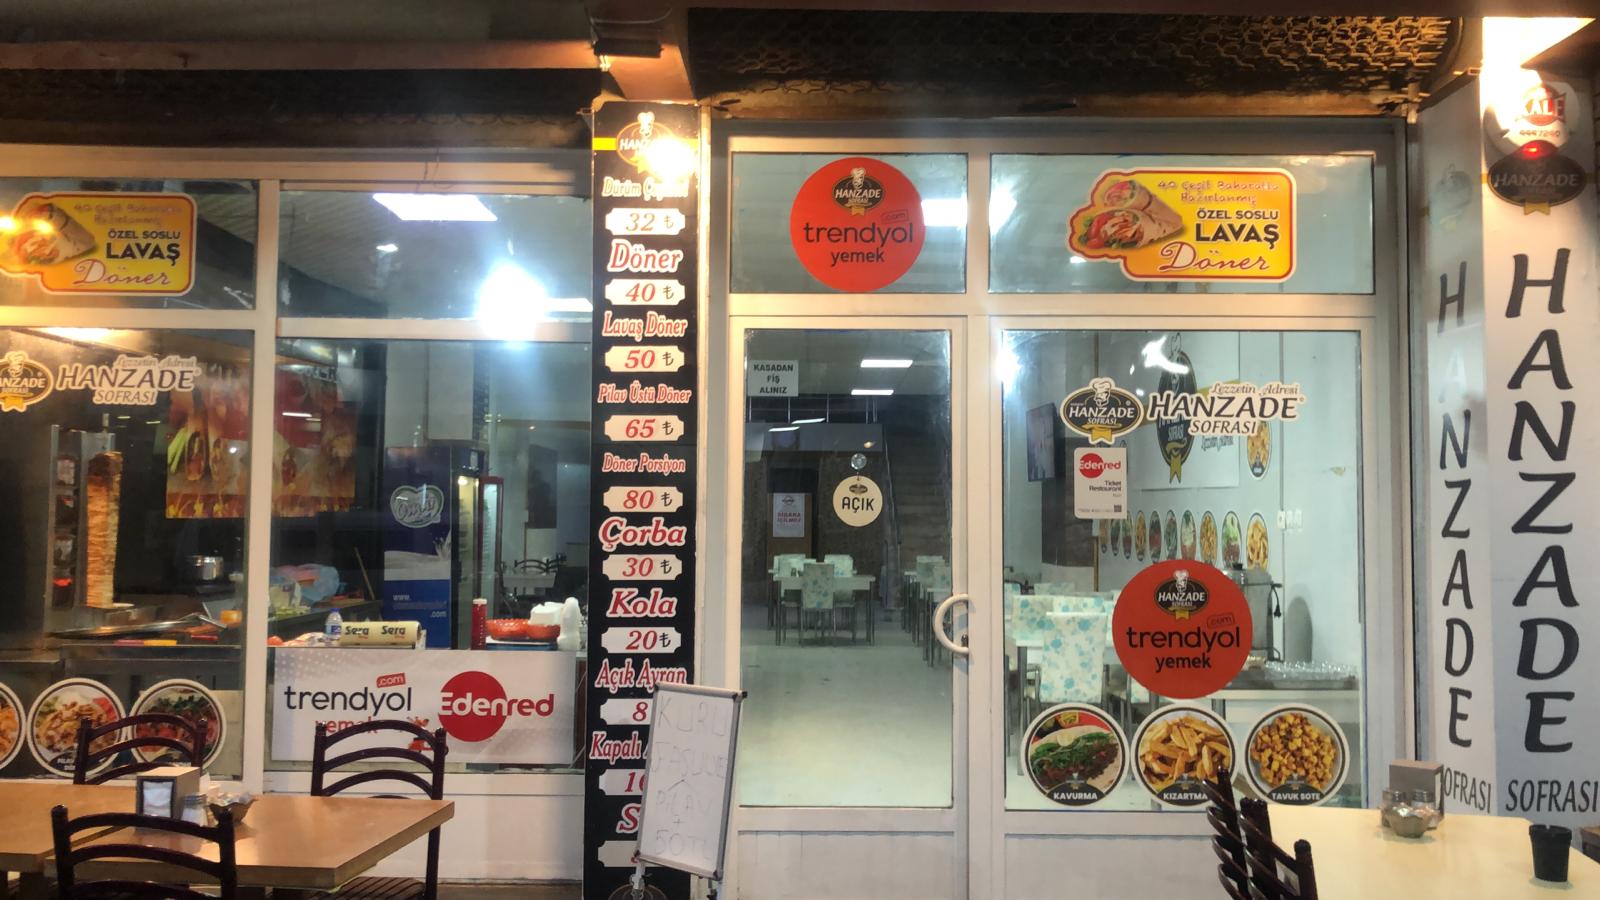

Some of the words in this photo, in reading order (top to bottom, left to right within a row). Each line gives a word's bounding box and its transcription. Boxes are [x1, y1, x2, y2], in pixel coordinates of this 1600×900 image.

[603, 177, 642, 197] Dürüm
[1496, 173, 1579, 187] HANZADE
[835, 188, 881, 200] HANZADE
[626, 213, 656, 232] 32
[1197, 209, 1232, 220] ÖZEL
[1235, 210, 1279, 220] SOSLU
[108, 230, 138, 240] ÖZEL
[142, 231, 181, 240] SOSLU
[803, 222, 913, 247] trendyol
[1196, 223, 1280, 249] LAVAŞ
[106, 243, 180, 266] LAVAŞ
[609, 241, 682, 271] Döner
[831, 248, 885, 267] yemek
[1159, 241, 1270, 271] Döner
[73, 258, 170, 286] Döner
[625, 283, 656, 302] 40
[603, 312, 643, 341] Lavaş
[646, 312, 688, 336] Döner
[624, 350, 656, 369] 50
[662, 352, 674, 367] ₺
[753, 364, 794, 372] KASADAN
[0, 377, 46, 389] NZADE
[59, 366, 194, 390] HANZADE
[767, 374, 780, 384] FİŞ
[95, 391, 156, 404] SOFRASI
[598, 384, 627, 403] Pilav
[629, 380, 656, 403] Üstü
[657, 384, 692, 403] Döner
[759, 386, 787, 394] ALINIZ
[1212, 382, 1256, 395] Lezzetin
[1258, 383, 1299, 396] Adresi
[1069, 405, 1135, 419] HANZADE
[1149, 394, 1299, 419] HANZADE
[625, 418, 656, 438] 65
[662, 421, 674, 436] ₺
[1190, 419, 1256, 434] SOFRASI
[602, 453, 639, 472] Döner
[639, 453, 686, 475] Porsiyon
[1079, 459, 1121, 470] Edenred
[623, 490, 655, 509] 80
[661, 492, 673, 507] ₺
[841, 496, 875, 513] AÇIK
[1505, 248, 1580, 753] HANZADE
[601, 518, 686, 551] Çorba
[622, 557, 654, 577] 30
[660, 559, 672, 574] ₺
[608, 589, 677, 616] Kola
[1158, 591, 1206, 602] HANZADE
[381, 625, 406, 636] Sera
[1210, 615, 1233, 626] .com
[625, 630, 658, 650] 20
[1126, 626, 1241, 653] trendyol
[1155, 652, 1212, 673] yemek
[377, 673, 405, 688] .com
[595, 659, 635, 693] Açık
[637, 659, 687, 693] Ayran
[284, 686, 412, 717] trendyol
[440, 694, 555, 718] Edenred
[632, 702, 649, 722] 8
[590, 732, 642, 765] Kapalı
[1054, 792, 1098, 801] KAVURMA
[1163, 792, 1208, 801] KIZARTMA
[1272, 792, 1299, 801] TAVUK
[1300, 792, 1321, 801] SOTE
[1441, 765, 1492, 814] OFRASI
[1505, 778, 1600, 813] SOFRASI
